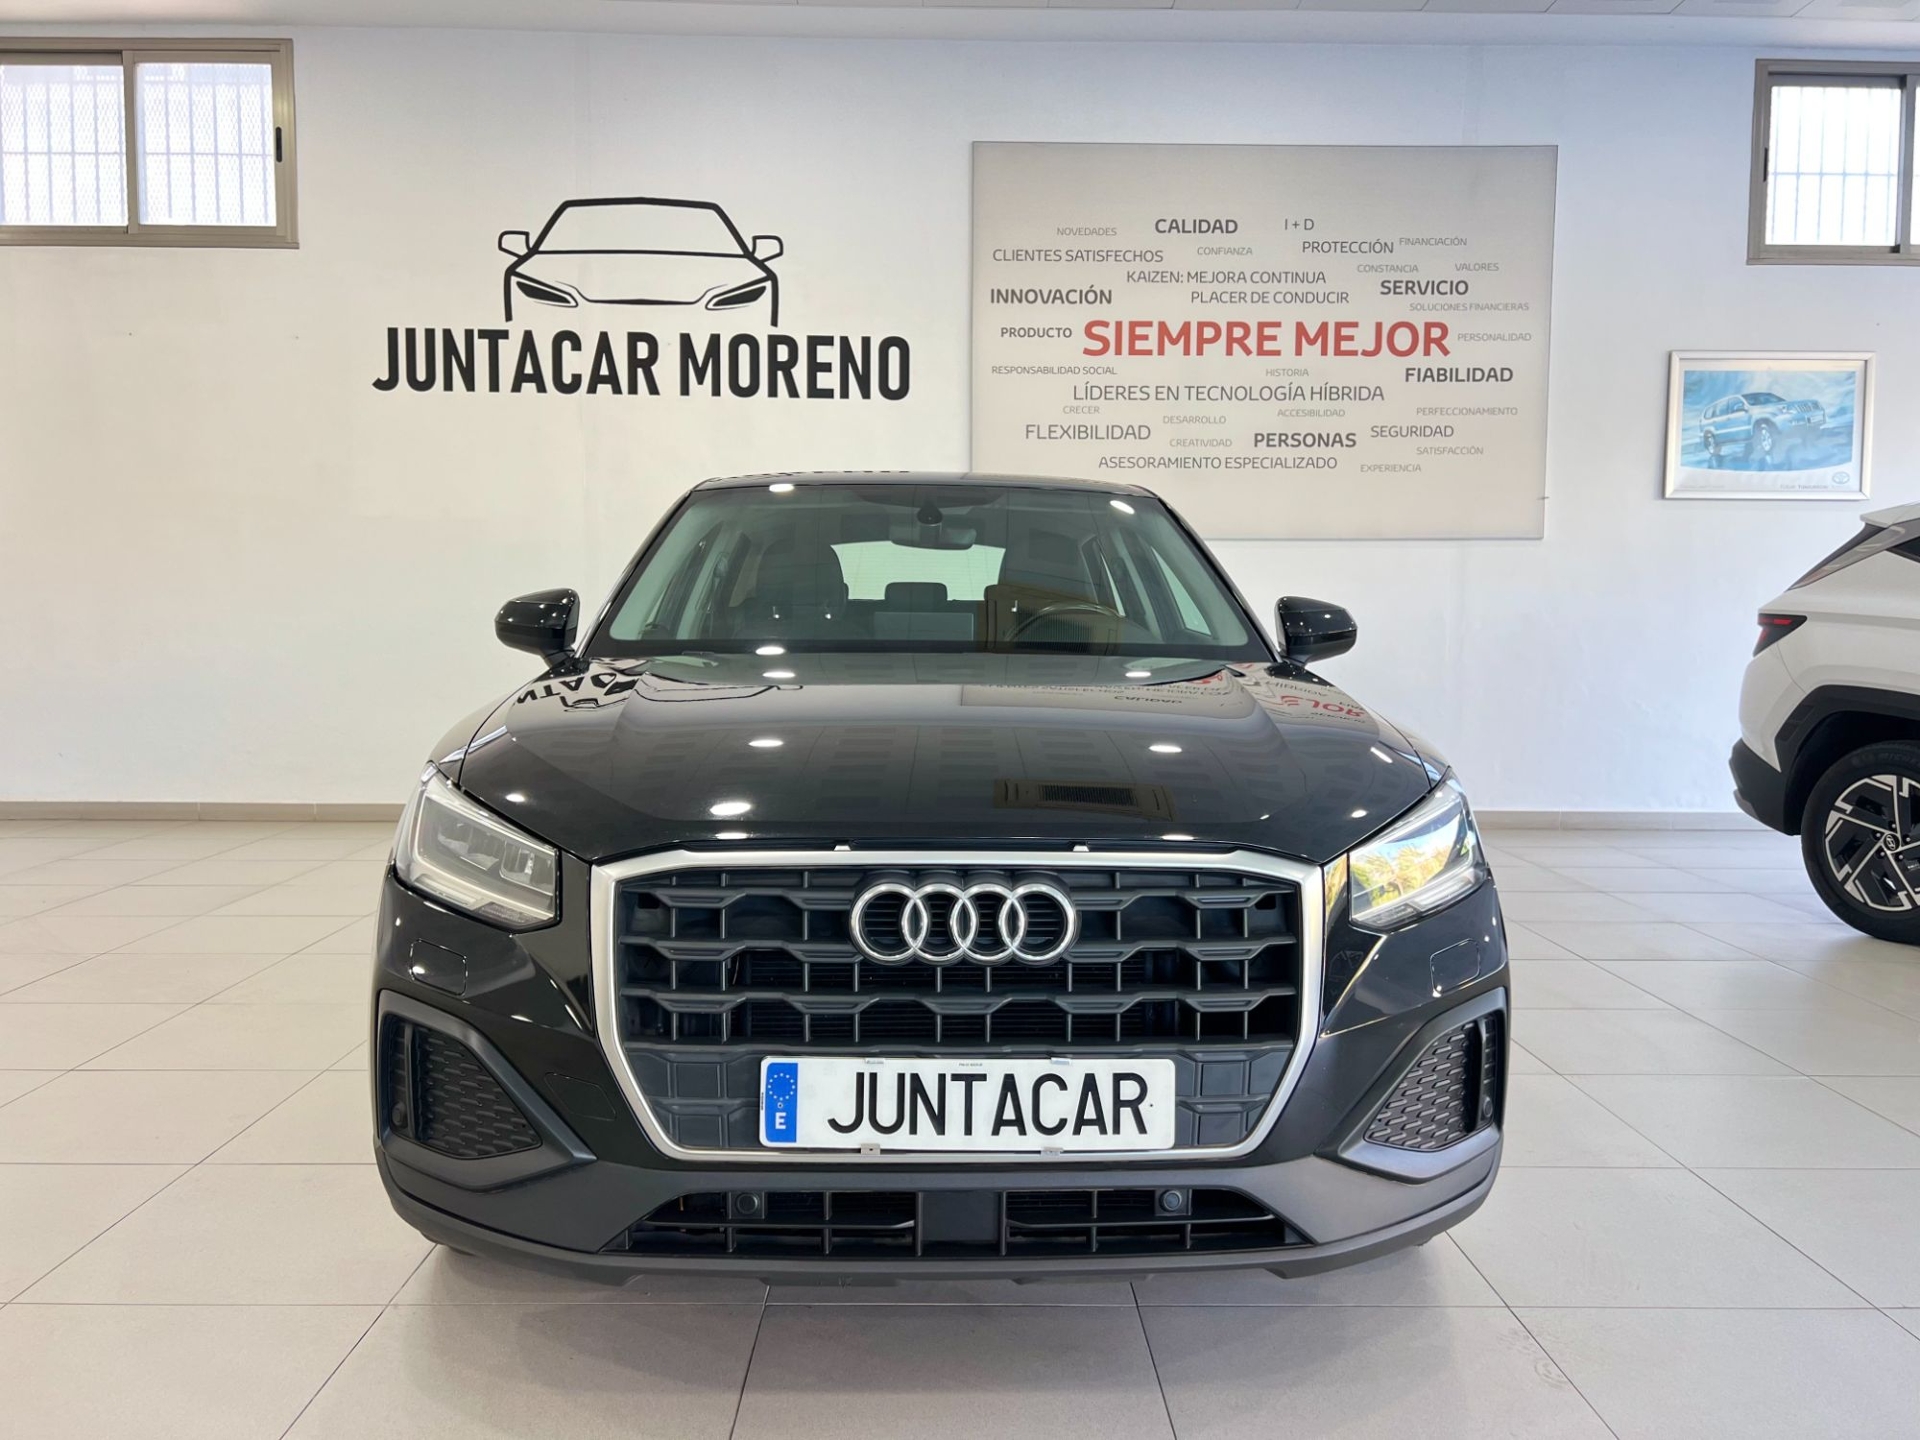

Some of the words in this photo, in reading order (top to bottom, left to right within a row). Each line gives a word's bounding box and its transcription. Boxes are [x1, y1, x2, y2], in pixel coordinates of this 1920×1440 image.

[1057, 227, 1117, 236] NOVEDADES
[1155, 218, 1238, 234] CALIDAD
[1302, 238, 1394, 253] PROTECCIÓN
[1399, 236, 1467, 246] FINANCIACIÓN
[993, 249, 1062, 261] CLIENTES
[1065, 250, 1163, 262] SATISFECHOS
[1197, 247, 1253, 255] CONFIANZA
[1357, 264, 1418, 273] CONSTANCIA
[1455, 262, 1499, 271] VALORES
[1127, 271, 1183, 283] KAIZEN:
[1187, 271, 1247, 283] MEJORA
[1250, 271, 1326, 284] CONTINUA
[1380, 280, 1469, 295] SERVICIO
[990, 285, 1112, 304] INNOVACIÓN
[1191, 291, 1247, 303] PLACER
[1251, 291, 1269, 303] DE
[1273, 291, 1349, 304] CONDUCIR
[1409, 302, 1467, 311] SOLUCIONES
[1469, 302, 1529, 311] FINANCIERAS
[1001, 327, 1072, 338] PRODUCTO
[1083, 320, 1282, 357] SIEMPRE
[1295, 321, 1450, 357] MEJOR
[1457, 332, 1531, 341] PERSONALIDAD
[372, 326, 660, 396] JUNTACAR
[679, 332, 910, 401] MORENO
[992, 366, 1080, 375] RESPONSABILIDAD
[1083, 366, 1117, 375] SOCIAL
[1265, 368, 1309, 377] HISTORIA
[1405, 367, 1513, 382] FIABILIDAD
[1073, 381, 1150, 400] LÍDERES
[1155, 386, 1179, 400] EN
[1185, 382, 1306, 401] TECNOLOGÍA
[1310, 382, 1384, 401] HÍBRIDA
[1063, 405, 1100, 414] CRECER
[1277, 408, 1345, 417] ACCESIBILIDAD
[1416, 407, 1518, 415] PERFECCIONAMIENTO
[1162, 415, 1226, 424] DESARROLLO
[1026, 424, 1151, 439] FLEXIBILIDAD
[1370, 425, 1454, 438] SEGURIDAD
[1169, 437, 1232, 447] CREATIVIDAD
[1254, 432, 1357, 447] PERSONAS
[1416, 445, 1484, 454] SATISFACCIÓN
[1098, 456, 1221, 468] ASESORAMIENTO
[1225, 456, 1337, 469] ESPECIALIZADO
[1360, 464, 1421, 472] EXPERIENCIA
[828, 1072, 1147, 1135] JUNTACAR
[775, 1112, 786, 1129] E
